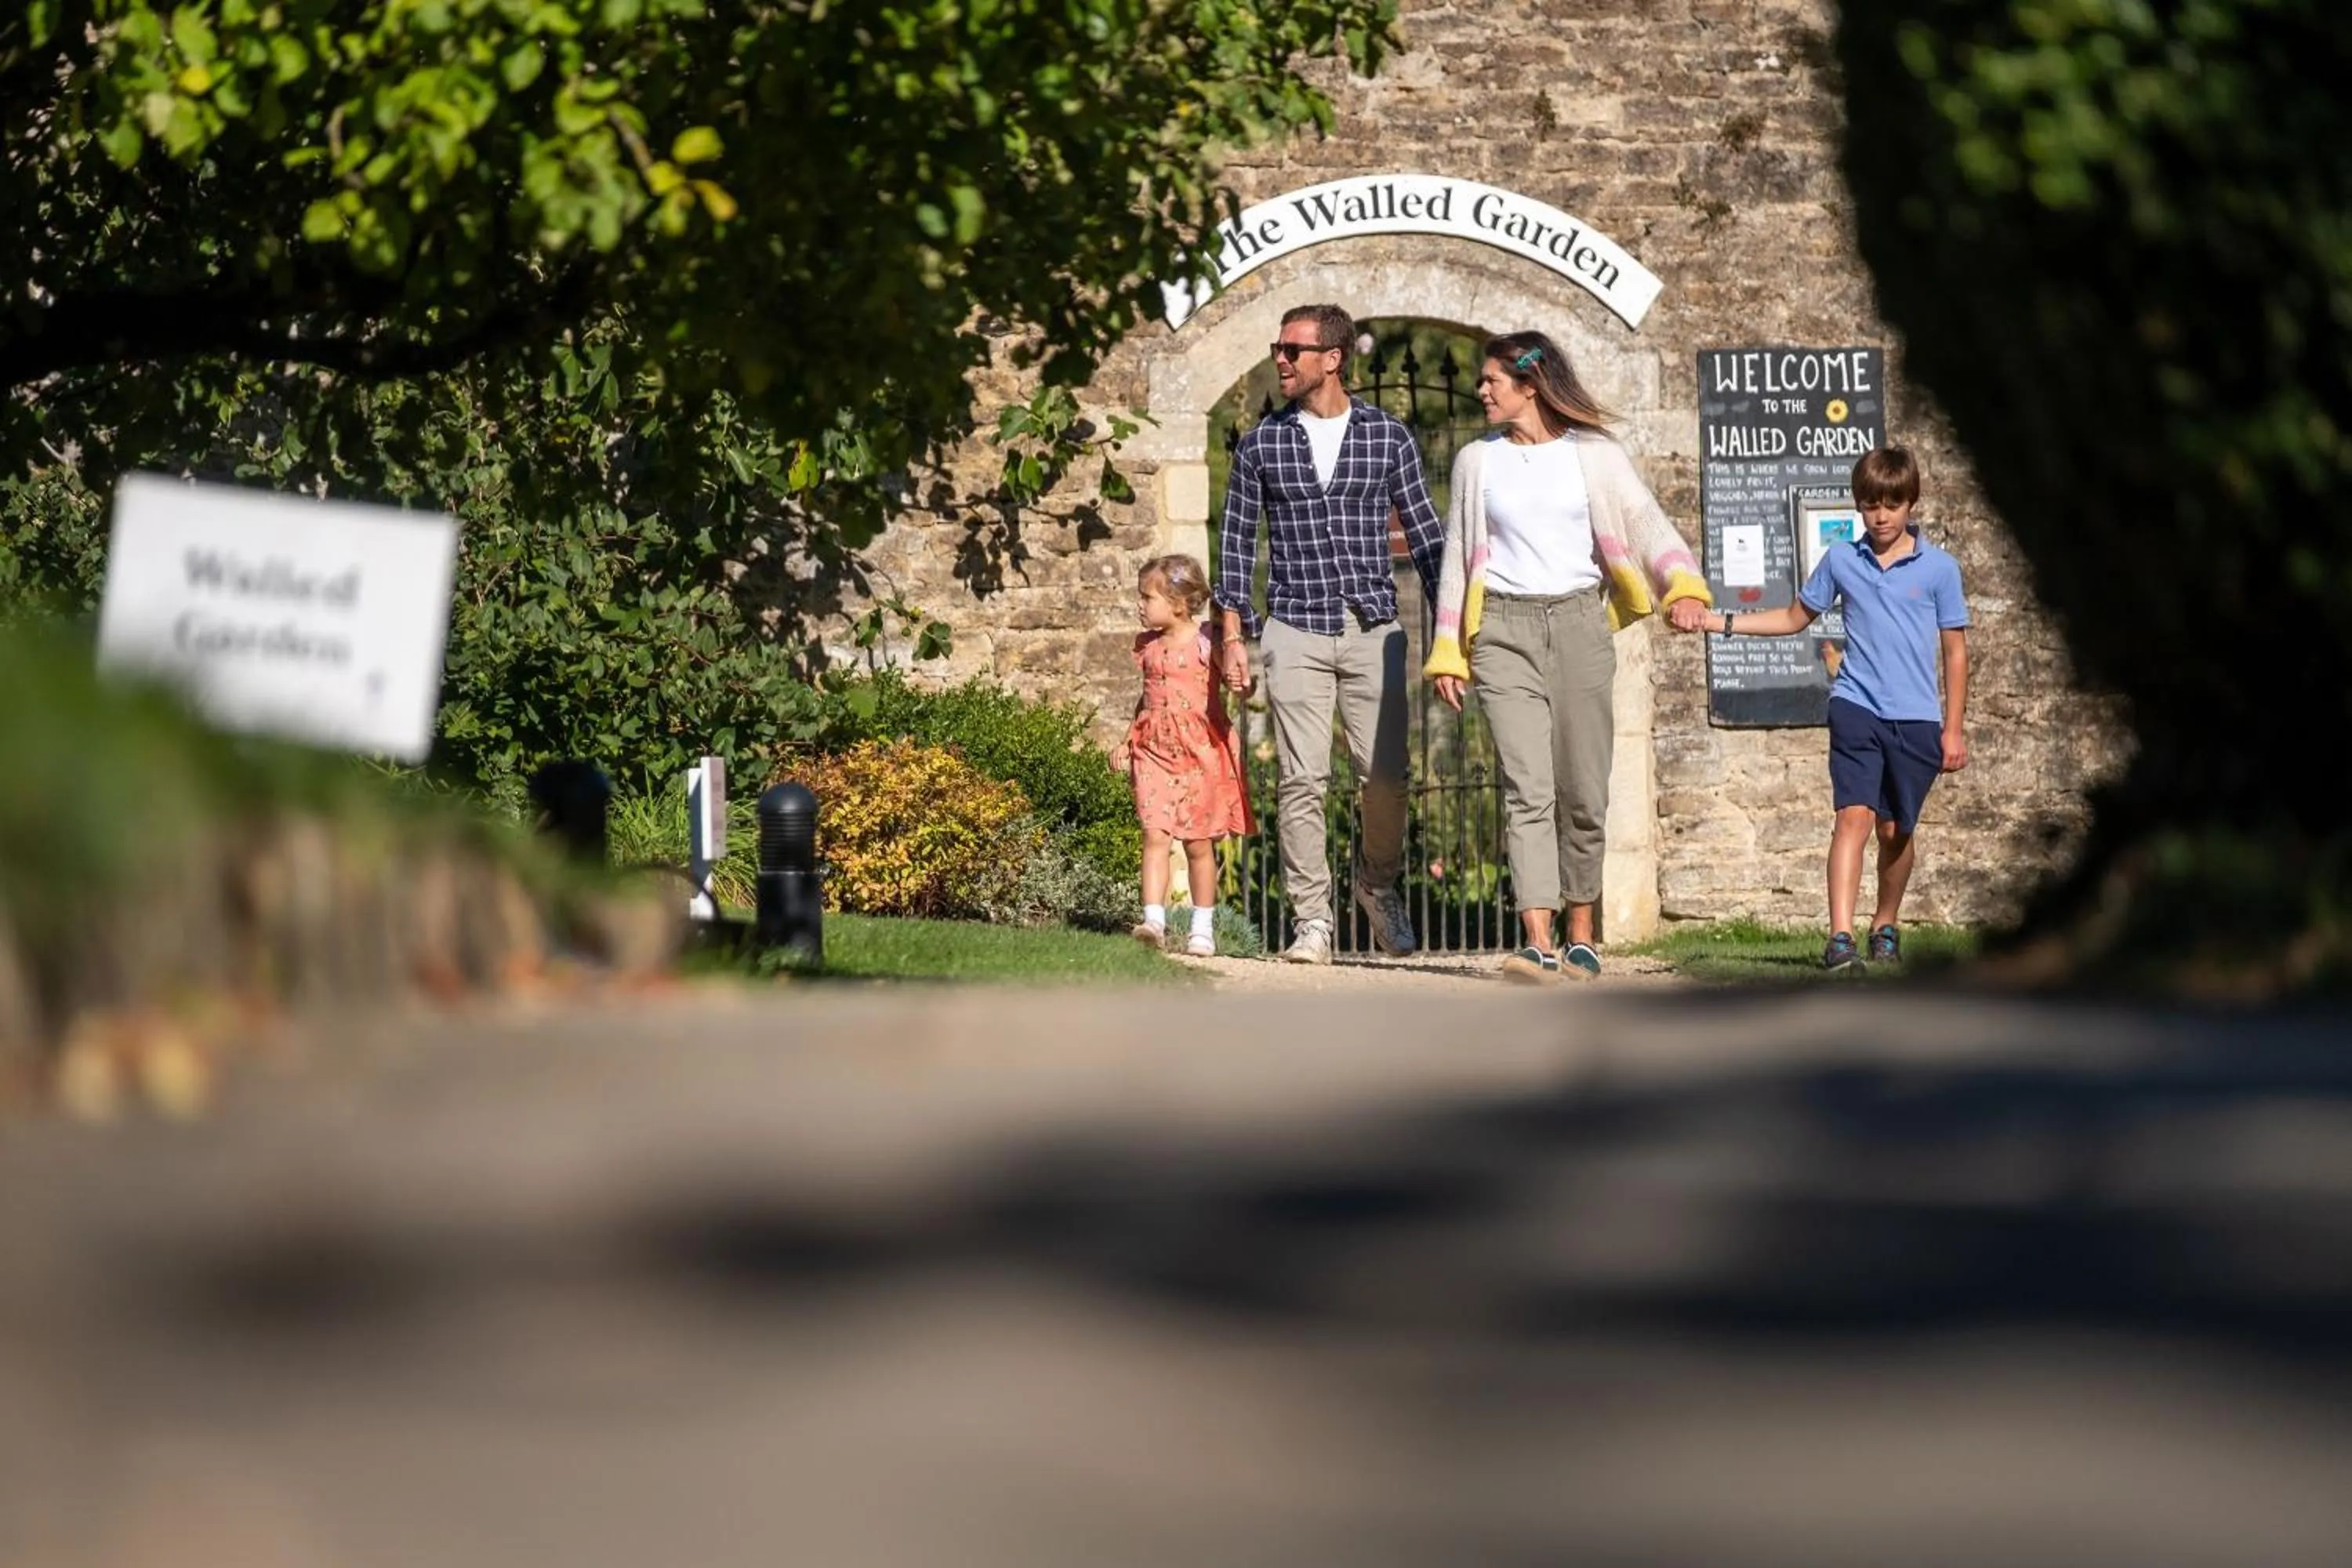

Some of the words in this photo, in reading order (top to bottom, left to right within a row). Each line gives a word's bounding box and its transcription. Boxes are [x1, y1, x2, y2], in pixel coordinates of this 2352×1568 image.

[1290, 183, 1452, 231] Walled
[1472, 193, 1621, 291] Garden
[1713, 352, 1871, 394] WELCOME
[1762, 399, 1779, 413] TO
[1782, 398, 1807, 414] THE
[1708, 424, 1786, 457] WALLED
[1796, 426, 1875, 457] GARDEN
[1735, 463, 1744, 475] IS
[1786, 464, 1798, 475] WE
[1708, 477, 1741, 488] LOVELY
[183, 545, 361, 612] Walled
[1769, 653, 1780, 662] SO
[1782, 653, 1795, 662] NO
